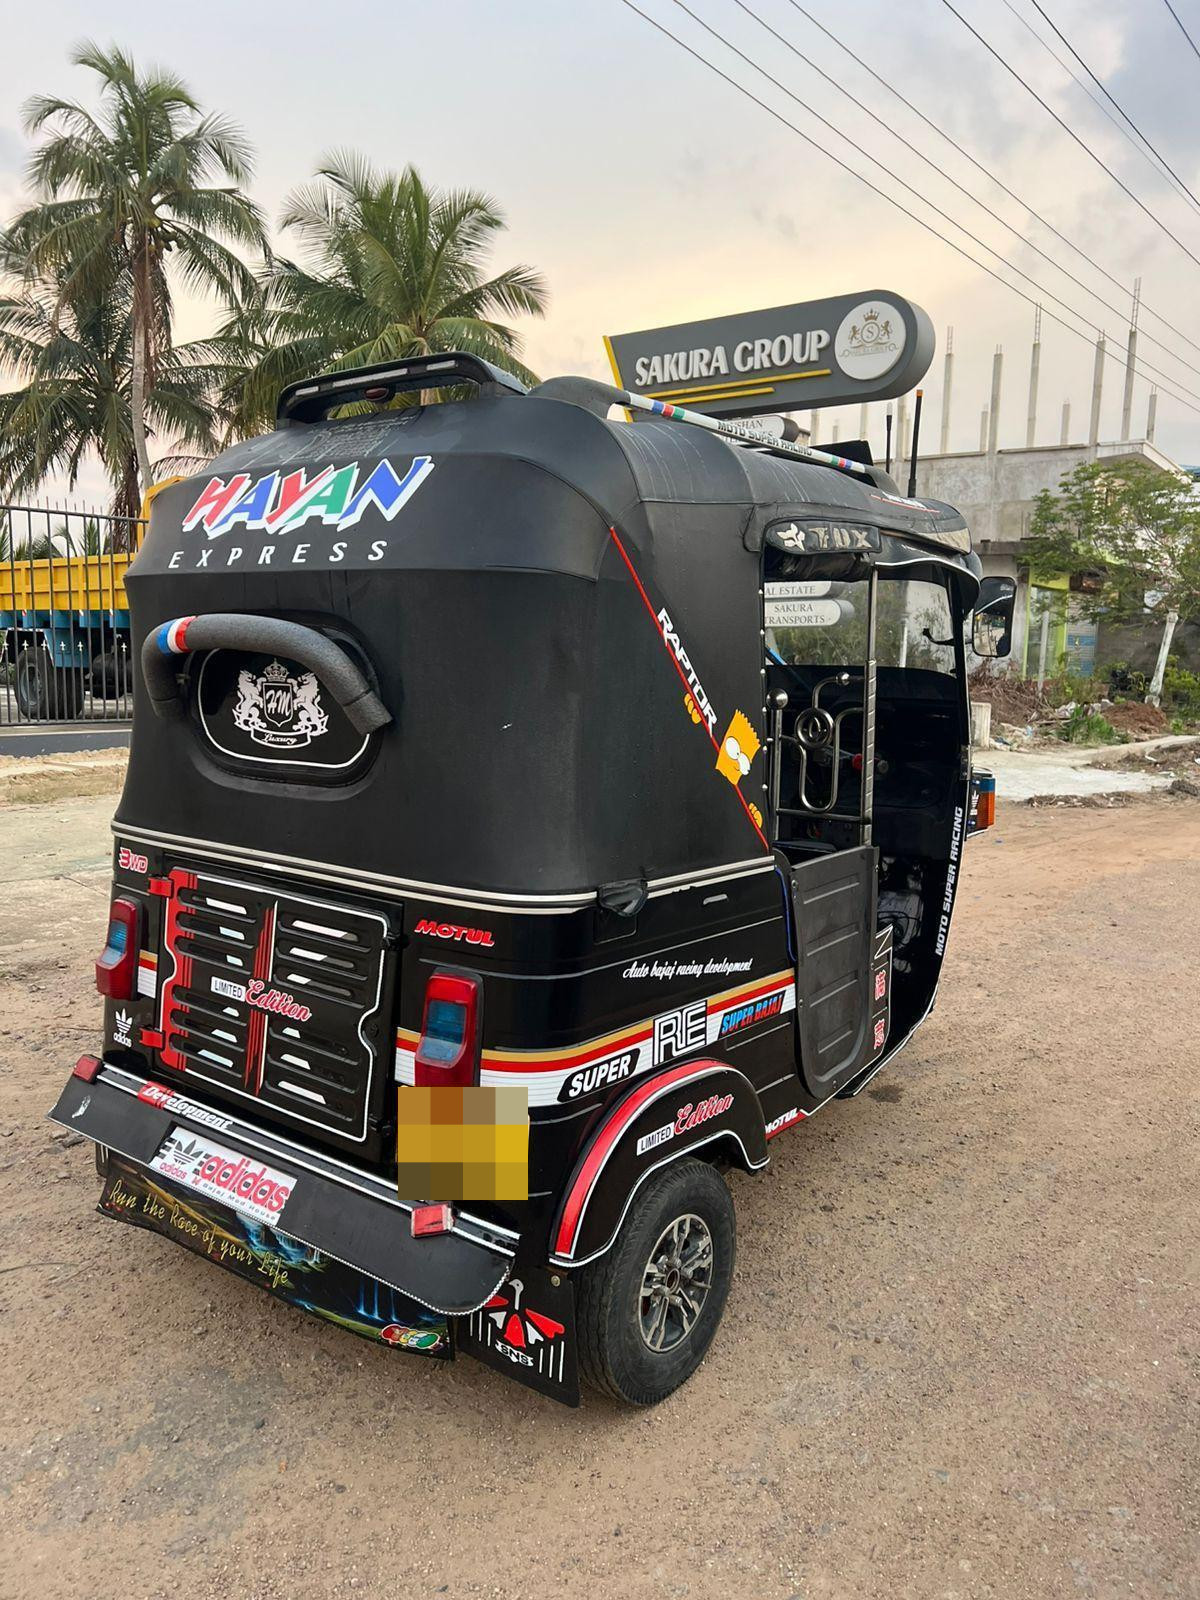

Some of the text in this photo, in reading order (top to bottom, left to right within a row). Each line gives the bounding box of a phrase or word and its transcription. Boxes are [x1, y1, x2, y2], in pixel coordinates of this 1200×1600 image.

[635, 329, 830, 386] SAKURA GROUP
[182, 455, 435, 540] HAYAN
[168, 540, 388, 569] EXPRESS
[774, 603, 814, 613] SAKURA
[779, 585, 816, 595] ESTATE
[657, 608, 718, 738] RAPTOR
[262, 733, 298, 745] Luxury
[118, 846, 149, 874] 3WD
[935, 806, 963, 956] MOTO SUPER RACING
[414, 919, 495, 948] MOTUL
[622, 957, 753, 980] Auto bajaj racing development
[213, 979, 312, 1022] LIMITED Edition
[721, 994, 783, 1035] SUPER BAJAJ
[653, 1000, 706, 1066] RE
[568, 1054, 632, 1098] SUPER
[143, 1086, 233, 1130] Development
[640, 1094, 734, 1151] LIMITED Edition
[765, 1107, 798, 1134] MOTUL
[159, 1162, 188, 1181] adidas
[200, 1156, 290, 1212] adidas
[109, 1179, 289, 1289] Run the Race of your Life
[500, 1345, 530, 1364] SNS
